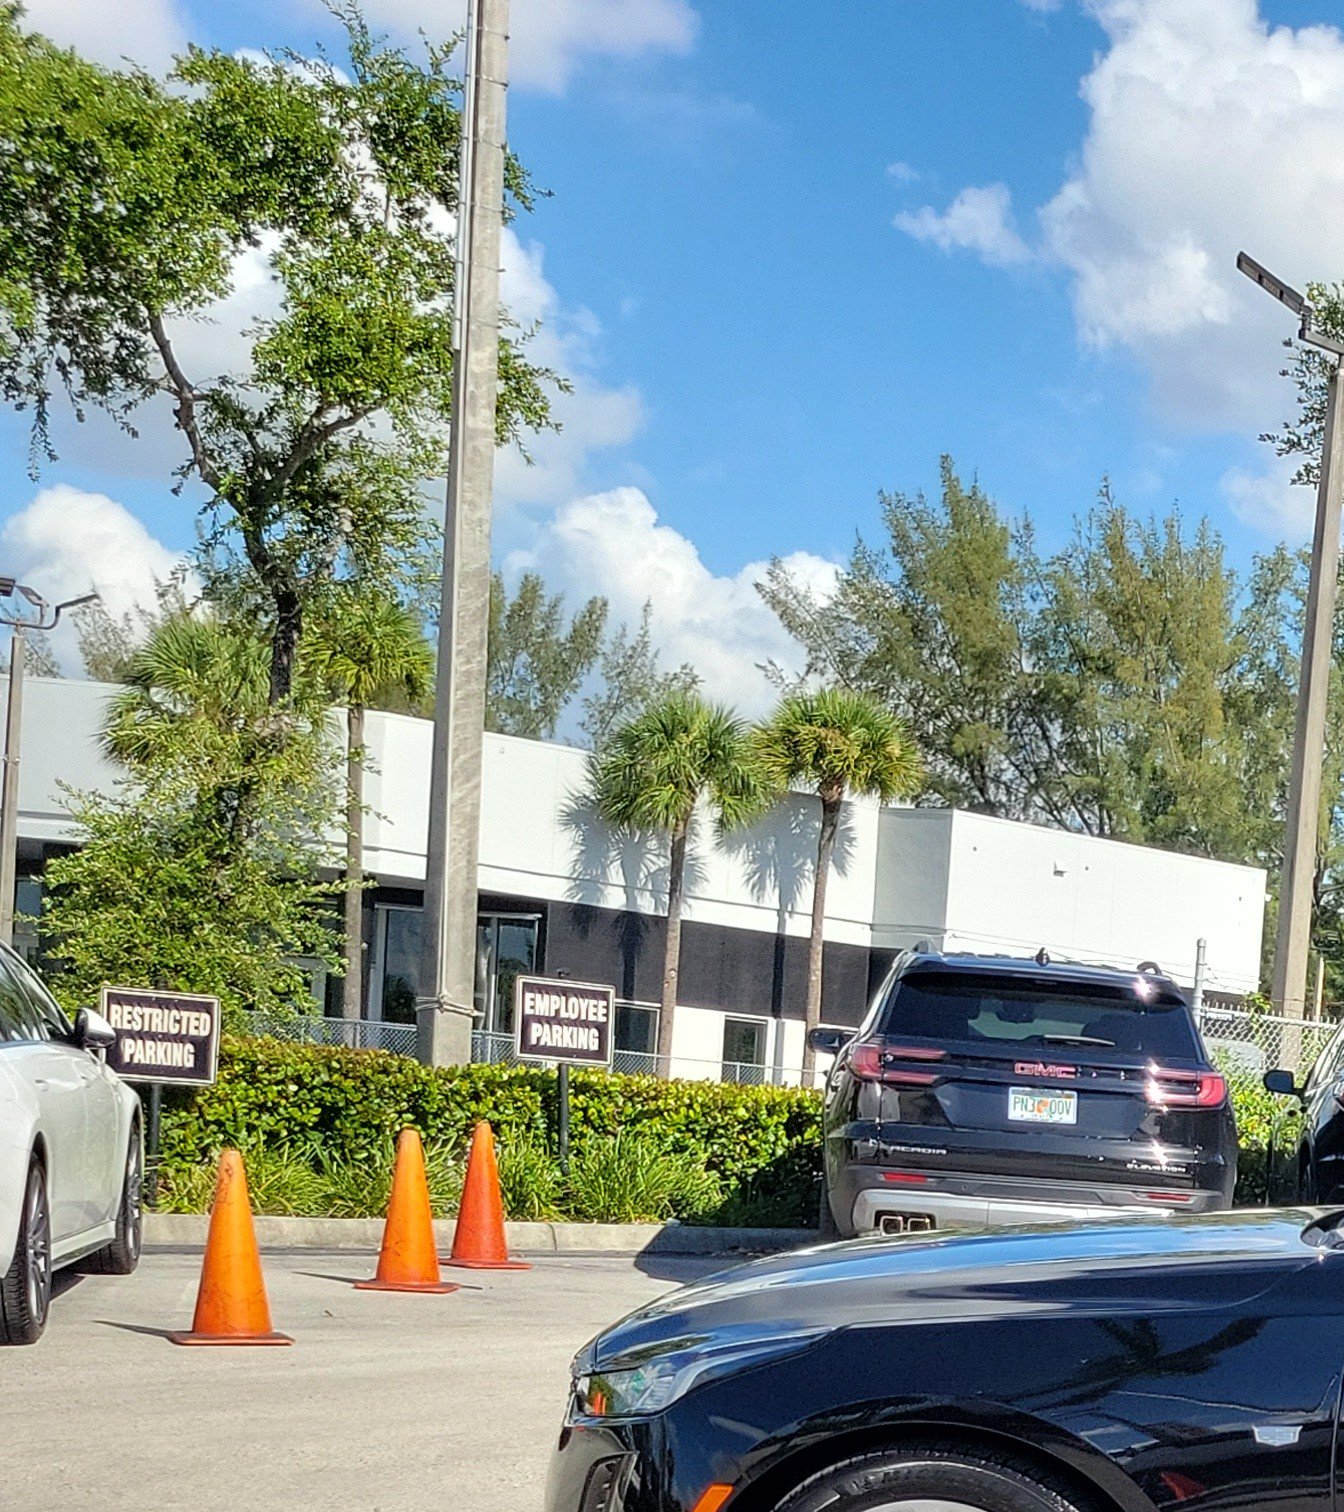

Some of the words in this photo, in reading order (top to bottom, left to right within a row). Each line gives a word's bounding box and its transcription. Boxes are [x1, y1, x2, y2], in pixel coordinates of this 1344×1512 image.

[110, 1003, 211, 1037] RESTRICTED
[524, 992, 607, 1022] EMPLOYEE
[530, 1022, 600, 1051] PARKING
[124, 1038, 195, 1068] PARKING
[1014, 1063, 1076, 1079] GMC
